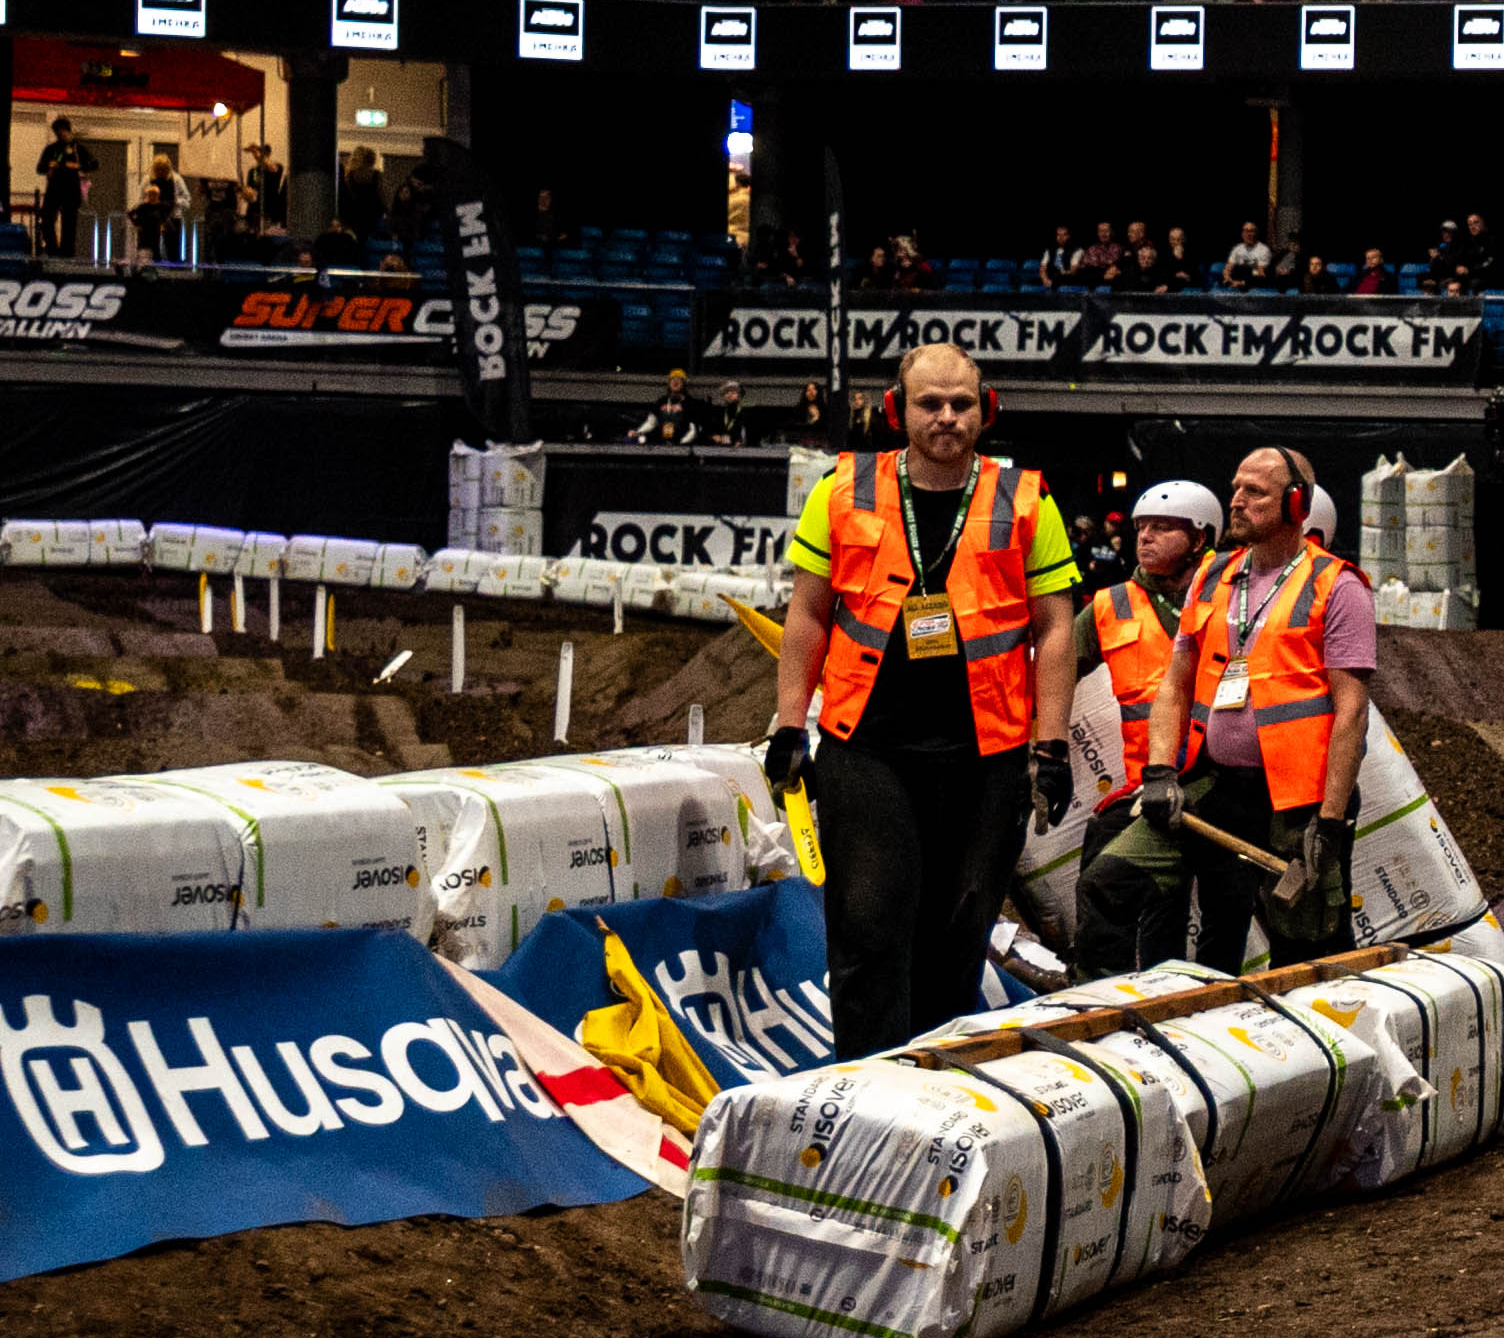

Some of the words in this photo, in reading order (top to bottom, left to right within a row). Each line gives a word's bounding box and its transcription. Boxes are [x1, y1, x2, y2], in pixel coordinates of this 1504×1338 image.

[234, 290, 413, 332] SUPER
[0, 319, 91, 340] ALLINN
[722, 317, 821, 350] ROCK
[905, 318, 1004, 351] ROCK
[1017, 316, 1064, 350] FM
[1104, 322, 1205, 355] ROCK
[1224, 322, 1271, 356] FM
[1294, 324, 1397, 357] ROCK
[1411, 323, 1463, 358] FM
[580, 522, 714, 567] ROCK
[128, 1018, 566, 1148] Husqva
